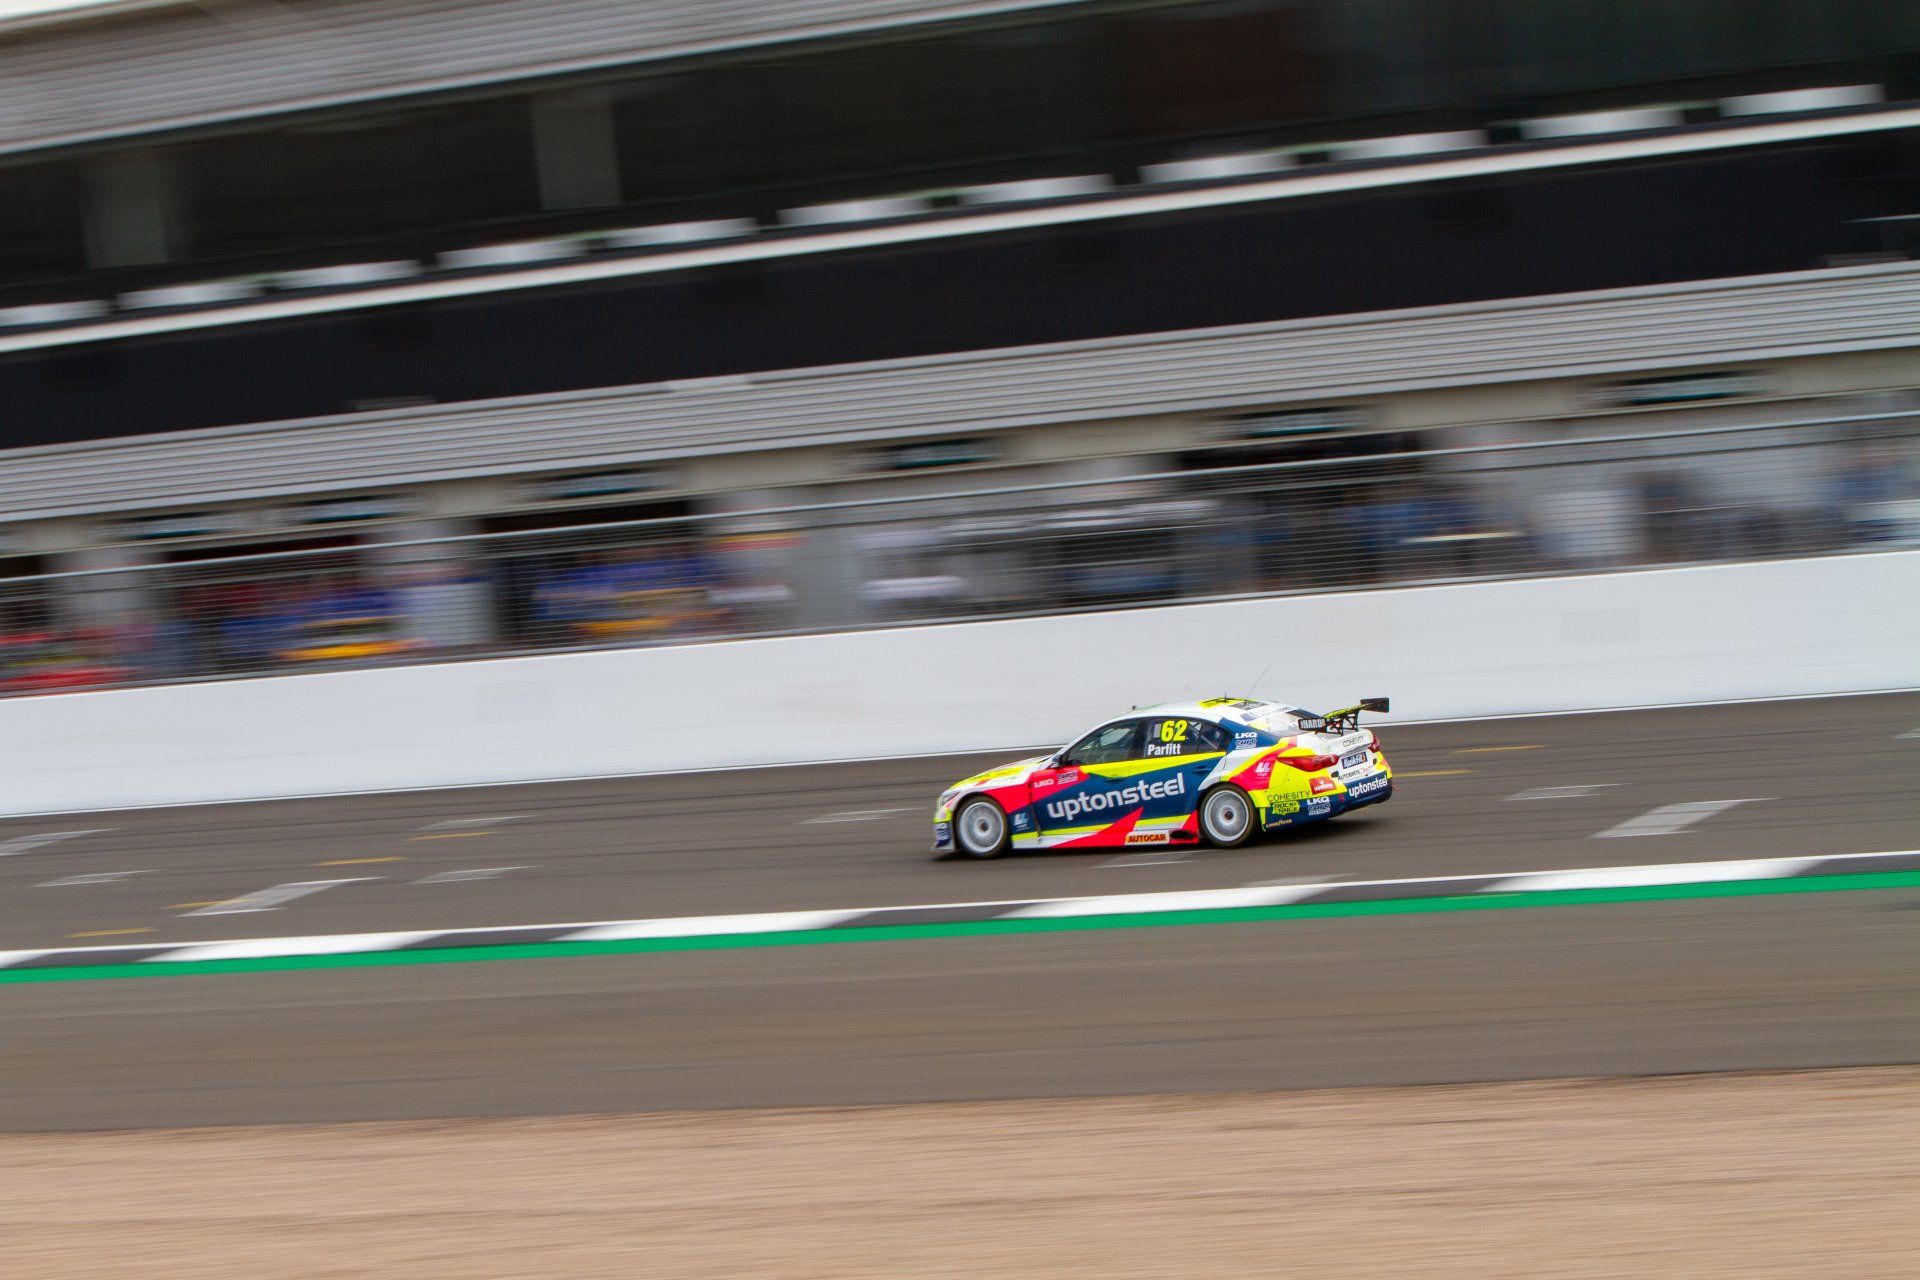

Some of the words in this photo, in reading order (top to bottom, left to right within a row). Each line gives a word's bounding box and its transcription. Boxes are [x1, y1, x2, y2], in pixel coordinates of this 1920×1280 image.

[1160, 719, 1188, 743] 62
[1147, 743, 1182, 756] Parfitt
[1348, 774, 1388, 799] uptonsteel
[1046, 772, 1185, 821] uptonsteel
[1267, 790, 1310, 802] COHESITY
[1306, 796, 1330, 805] LKQ
[1127, 833, 1167, 844] AUTOCAR
